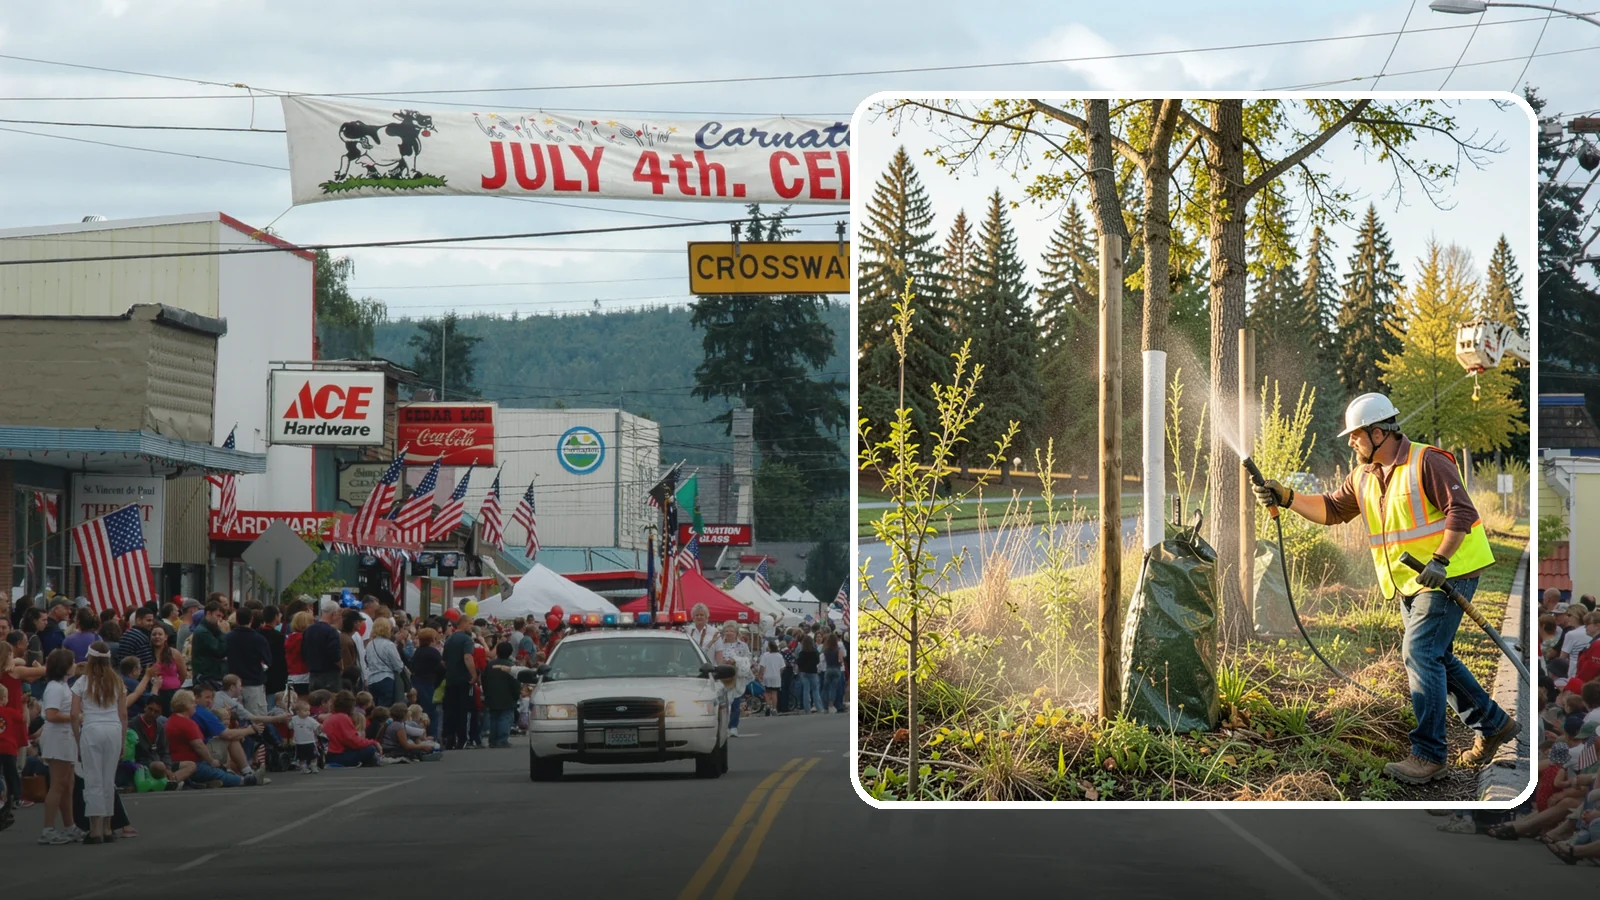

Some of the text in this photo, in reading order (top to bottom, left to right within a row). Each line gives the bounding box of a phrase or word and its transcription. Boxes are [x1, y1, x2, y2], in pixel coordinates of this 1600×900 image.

[481, 141, 605, 192] JULY
[632, 150, 747, 198] 4th.
[697, 254, 850, 280] CROSSWA
[283, 380, 373, 420] ACE
[405, 409, 485, 422] CEDAR LOG
[283, 421, 371, 436] Hardware
[416, 428, 477, 447] Coca-Cola
[354, 467, 386, 480] Simpl
[83, 485, 155, 495] St. Vincent de Paul
[81, 503, 153, 522] THT
[688, 526, 742, 535] CRNATION
[699, 535, 730, 543] GLASS
